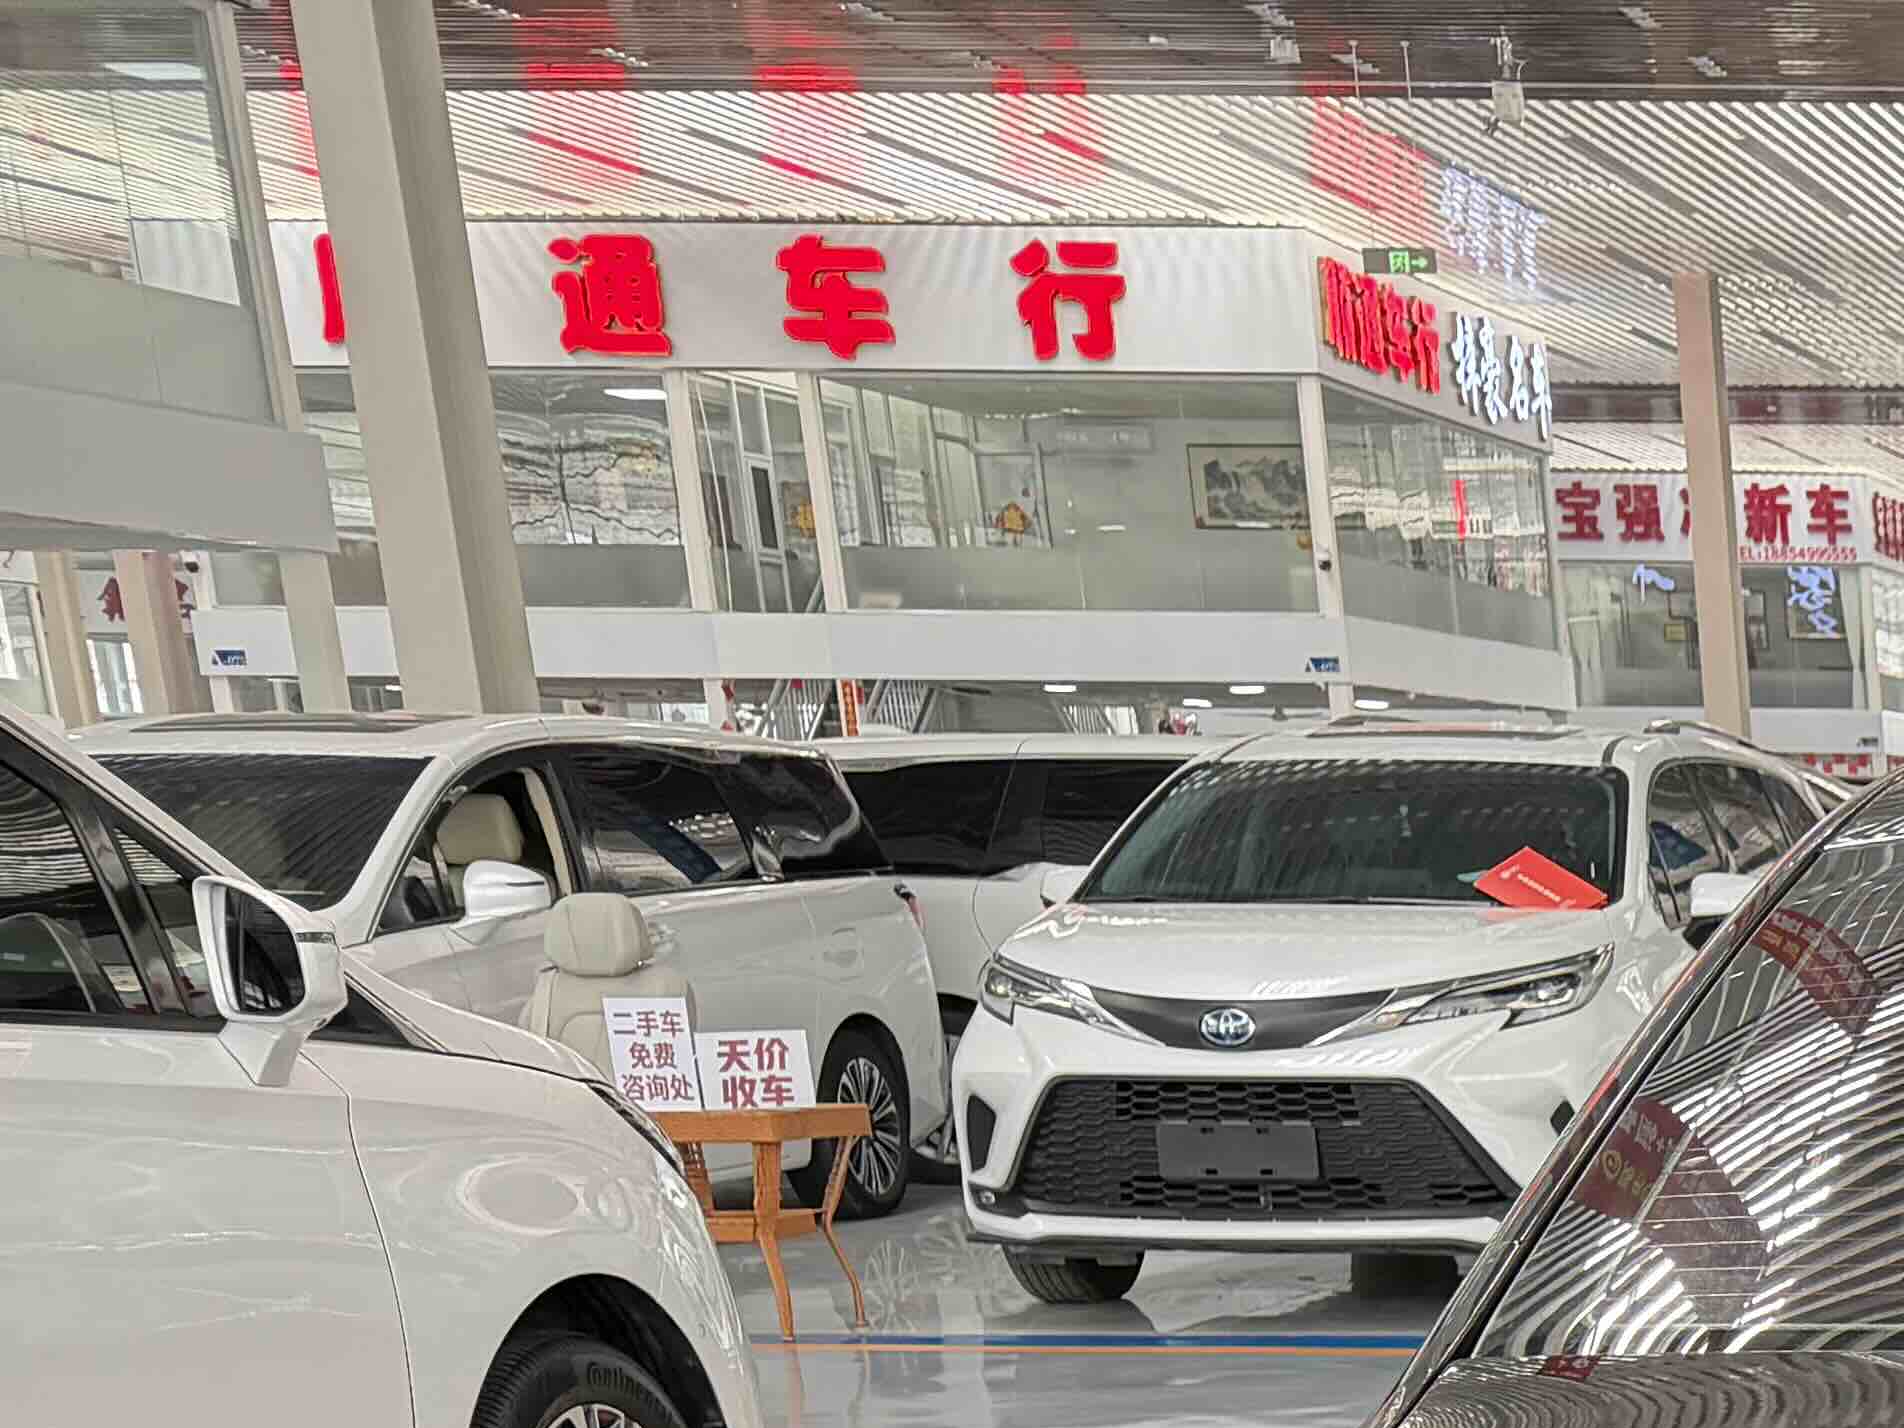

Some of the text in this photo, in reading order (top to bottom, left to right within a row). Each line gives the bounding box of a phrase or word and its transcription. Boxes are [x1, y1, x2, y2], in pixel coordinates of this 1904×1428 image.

[313, 233, 1126, 362] 通车行
[1555, 480, 1853, 546] 宝强新车
[612, 1010, 685, 1039] 二手车
[629, 1042, 678, 1070] 免费
[717, 1038, 790, 1073] 天价
[621, 1073, 695, 1102] 咨询处
[722, 1074, 795, 1110] 收车
